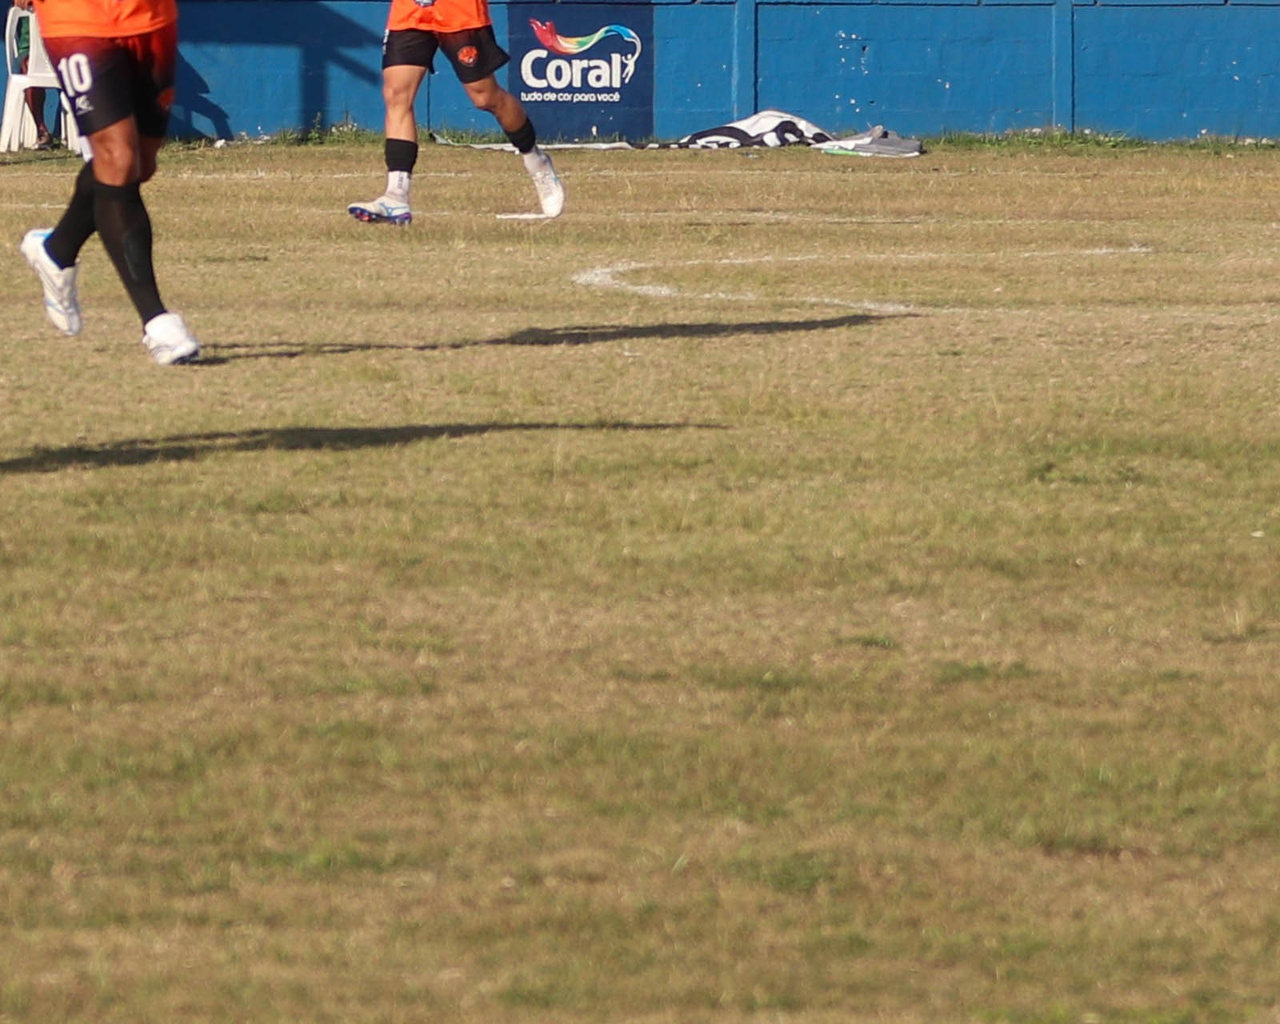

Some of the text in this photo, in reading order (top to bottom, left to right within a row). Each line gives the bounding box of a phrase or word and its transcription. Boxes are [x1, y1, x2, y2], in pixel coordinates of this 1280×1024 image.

[58, 53, 92, 97] 10
[520, 48, 621, 89] Coral
[520, 92, 620, 102] tudo de cor para você
